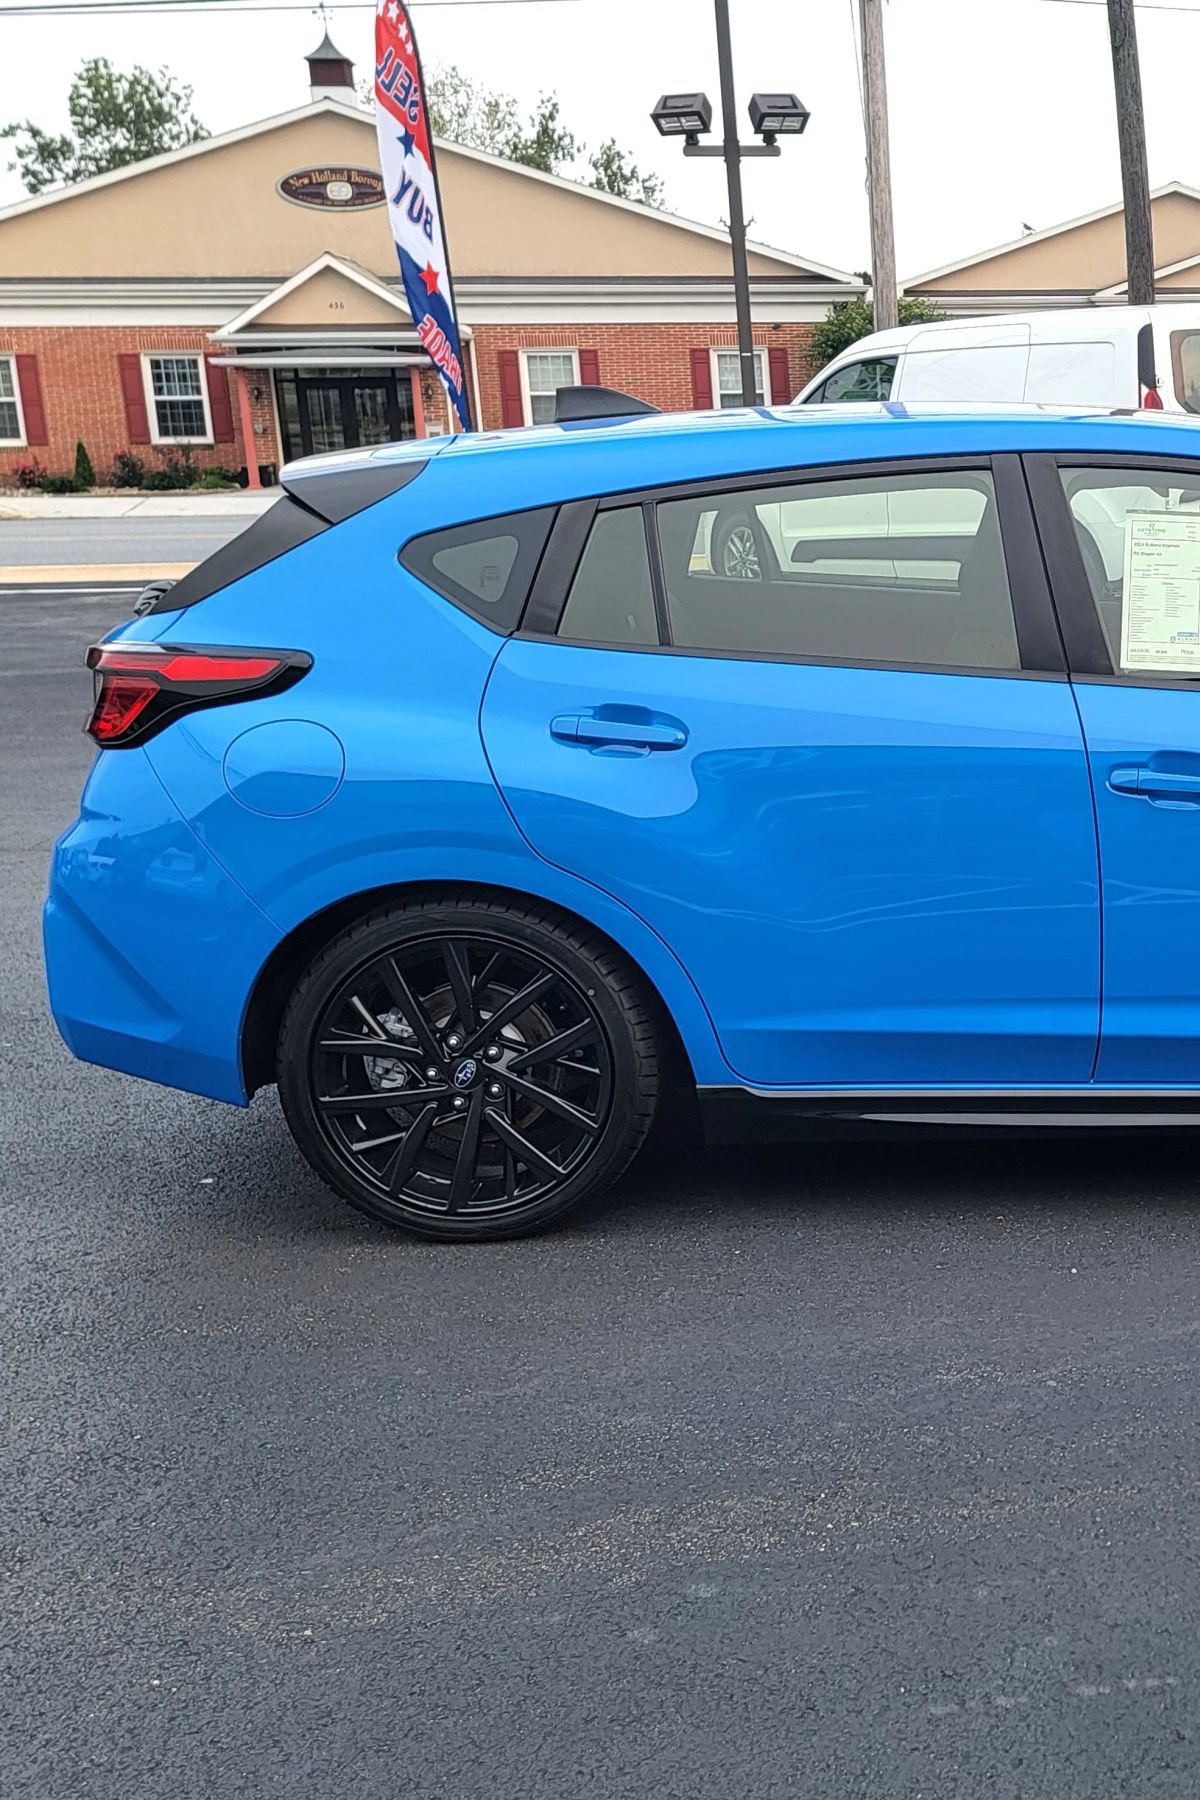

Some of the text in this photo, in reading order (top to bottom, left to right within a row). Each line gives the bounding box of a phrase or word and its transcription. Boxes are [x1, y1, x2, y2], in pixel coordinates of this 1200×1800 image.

[288, 170, 384, 191] New Holland Boroug
